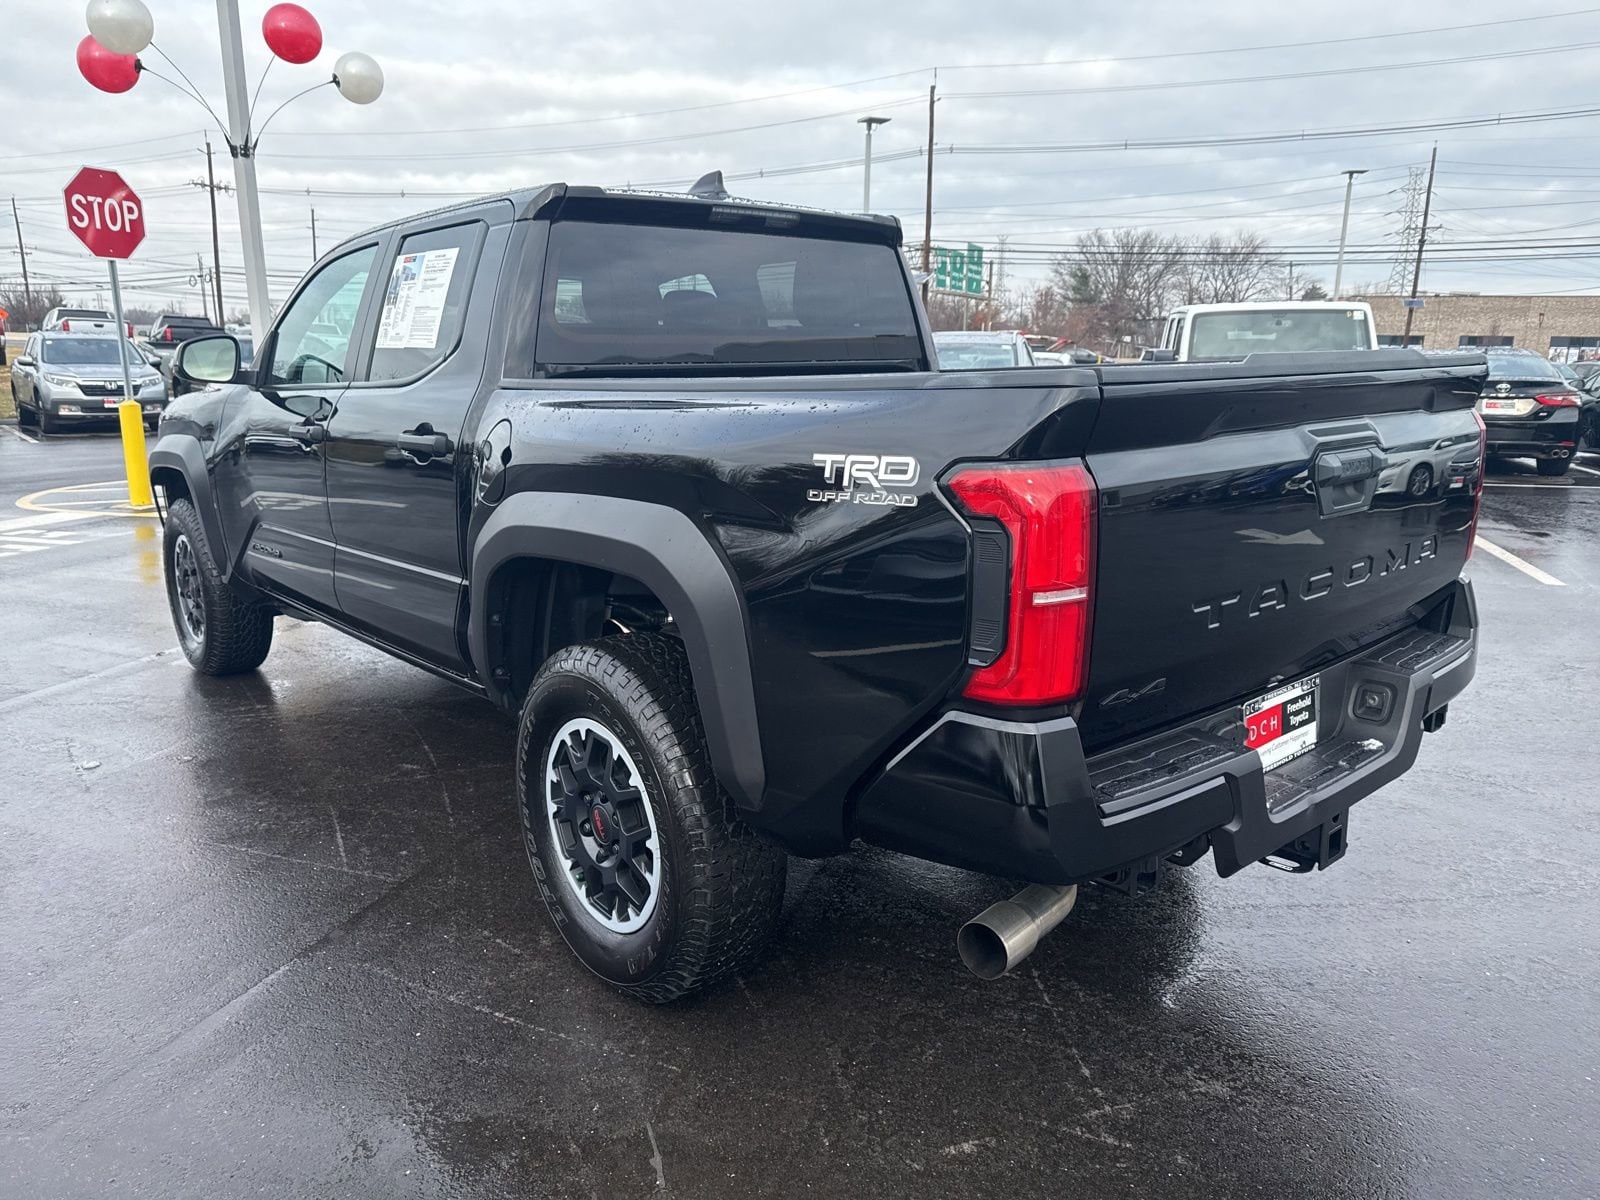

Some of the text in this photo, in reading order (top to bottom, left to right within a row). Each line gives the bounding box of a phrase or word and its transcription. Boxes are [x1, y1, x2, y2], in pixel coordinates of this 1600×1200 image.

[71, 193, 139, 233] STOP
[812, 453, 920, 493] TRD
[806, 489, 919, 507] OFF ROAD
[1192, 535, 1438, 629] TACOMA
[1286, 694, 1312, 714] Freehold
[1249, 714, 1279, 741] DCH
[1289, 711, 1309, 726] Toyota
